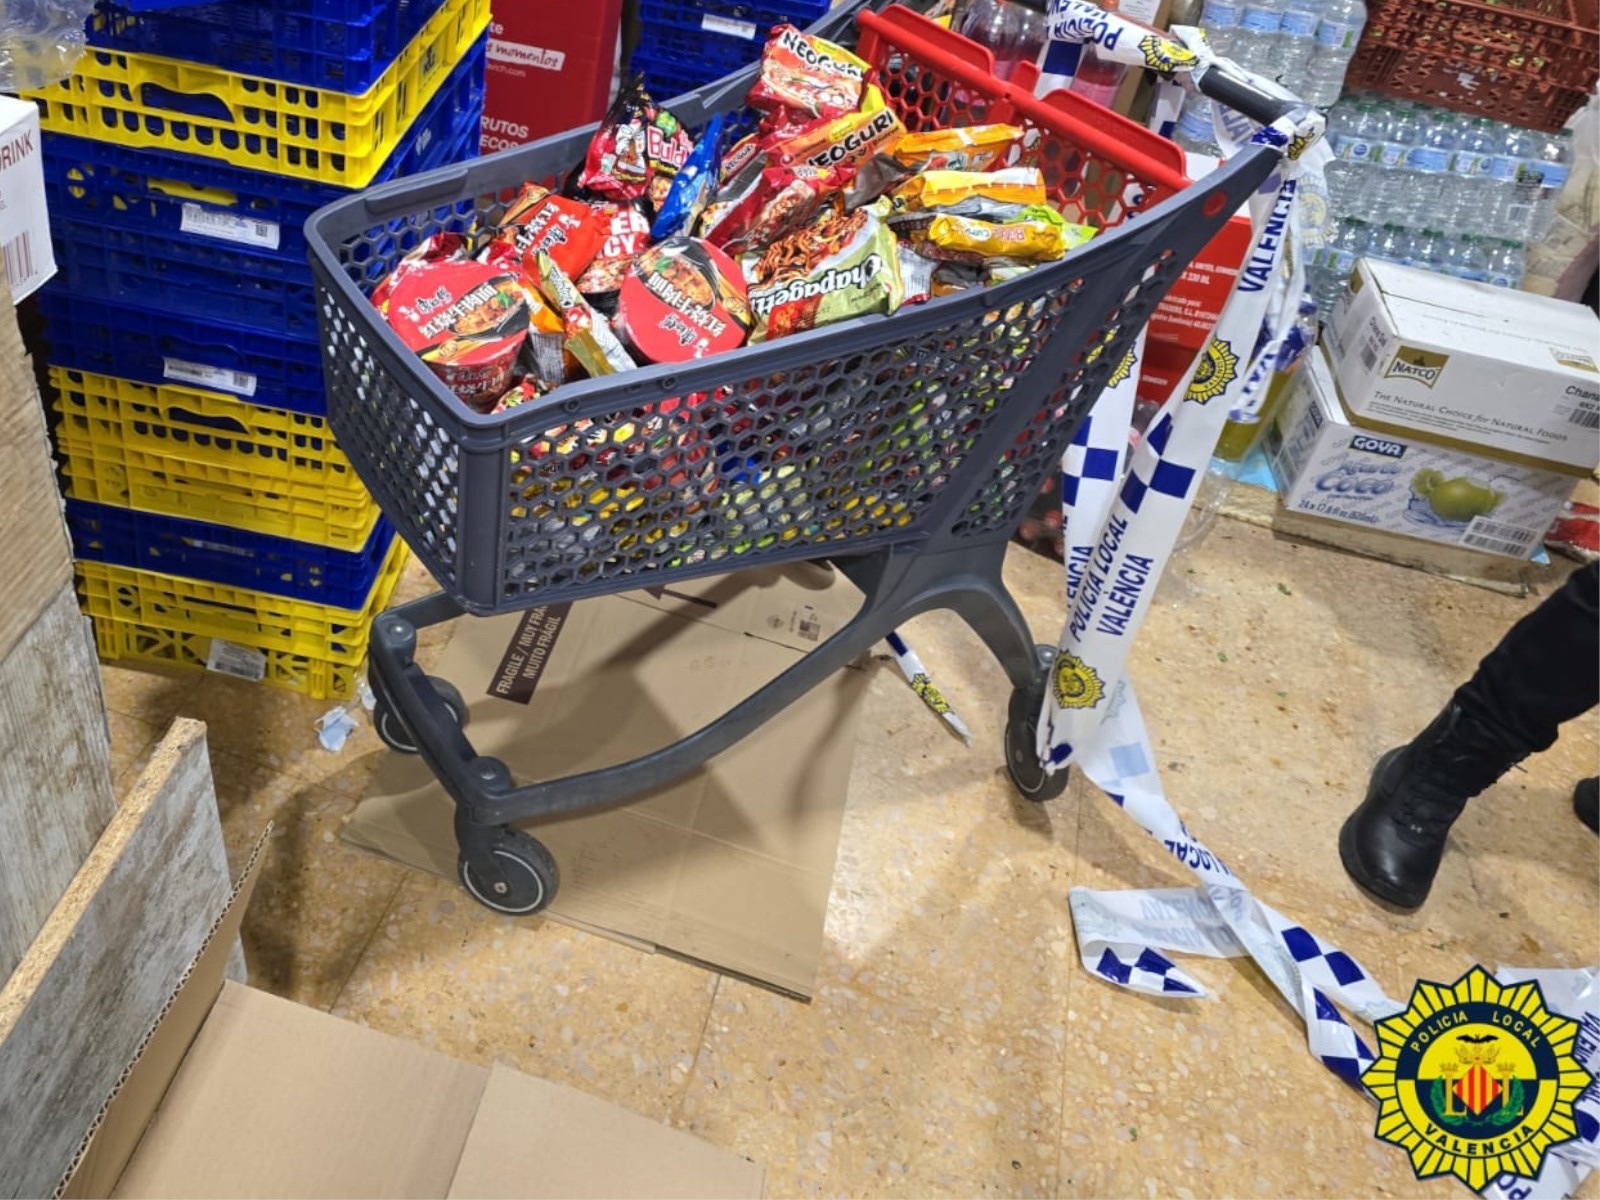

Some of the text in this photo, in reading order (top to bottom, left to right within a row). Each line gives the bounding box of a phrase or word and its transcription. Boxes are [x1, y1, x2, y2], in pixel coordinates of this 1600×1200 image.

[490, 21, 504, 35] te
[480, 115, 530, 139] RUTOS
[480, 134, 520, 150] ECOS
[0, 129, 34, 171] RINK
[647, 126, 689, 168] Buld
[1393, 360, 1437, 381] NATCO
[1394, 396, 1436, 413] NATURAL
[1491, 418, 1534, 434] NATURAL
[1353, 437, 1402, 456] GOYA
[1066, 546, 1094, 600] ENCIA
[1069, 572, 1104, 643] POLICIA
[1094, 513, 1128, 574] LOCAL
[496, 653, 525, 694] FRAGILE
[518, 623, 539, 647] MUY
[522, 648, 547, 679] MUITO
